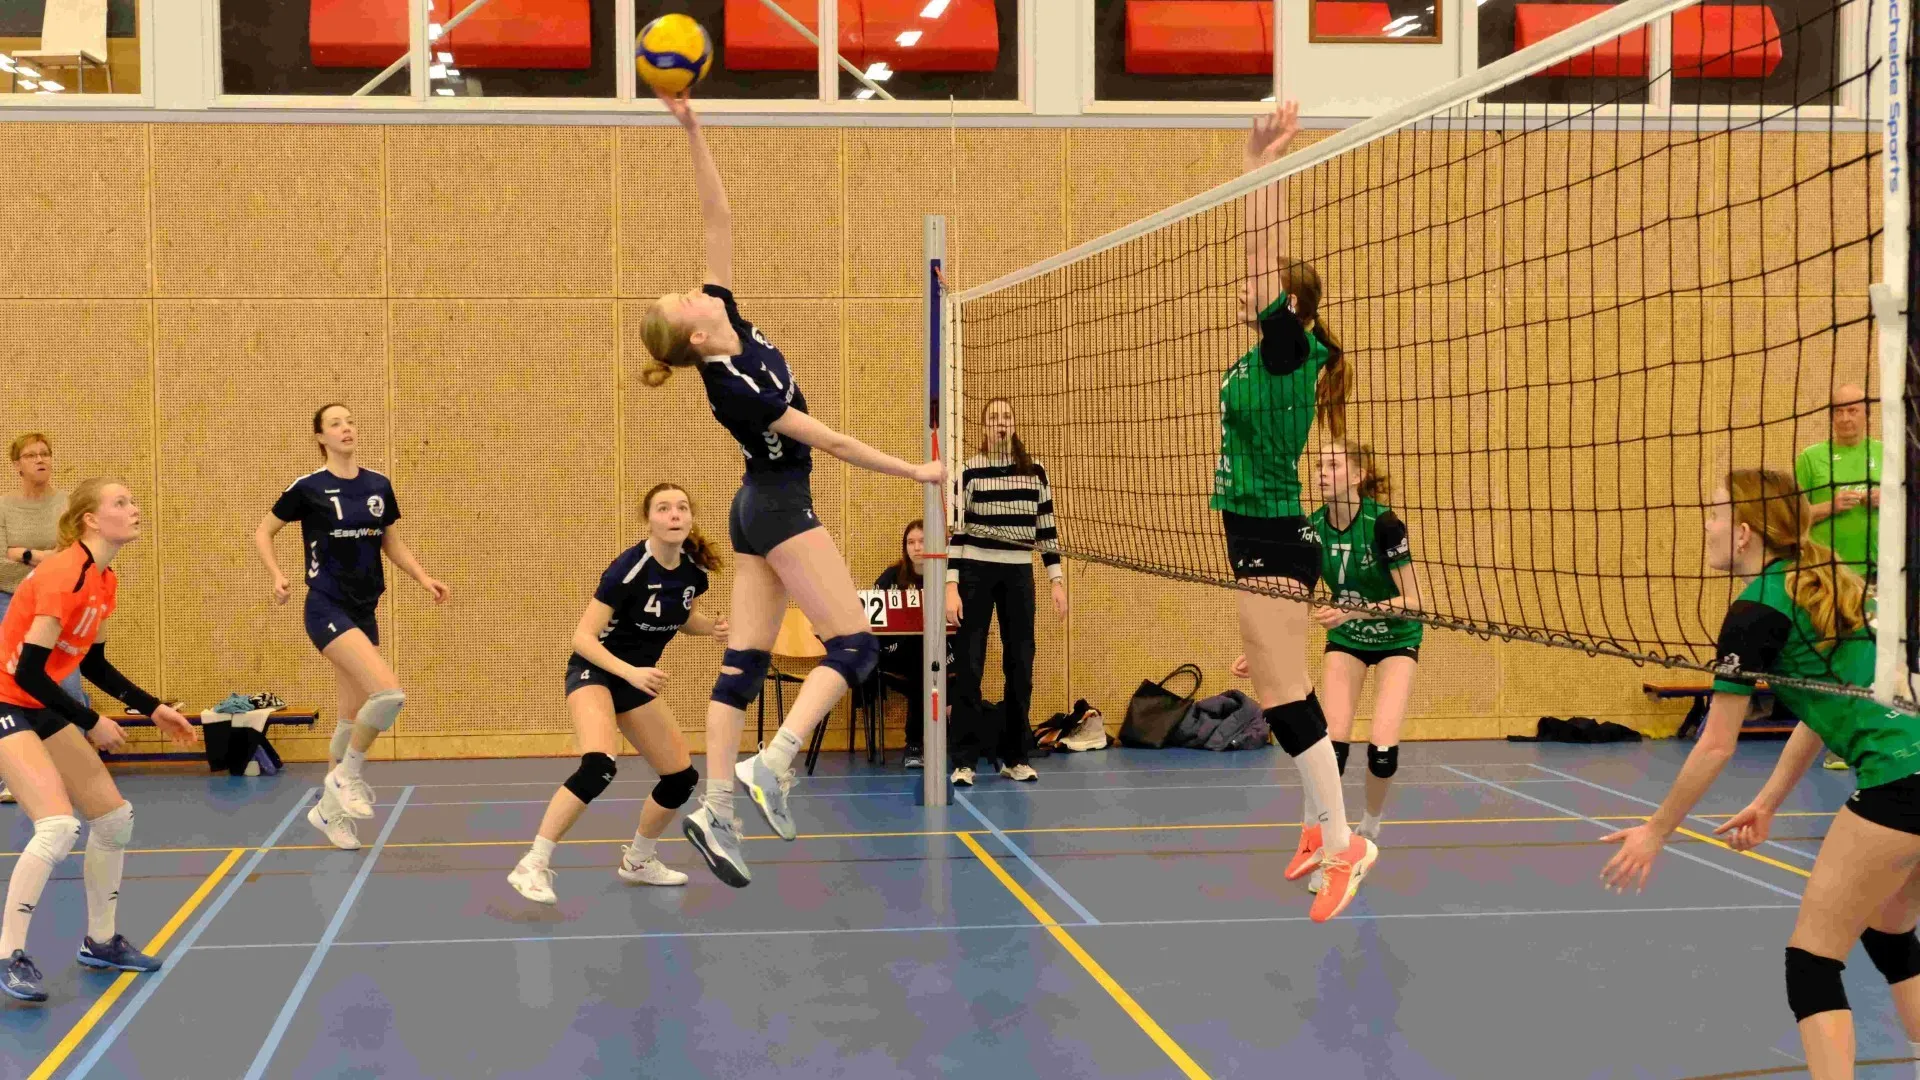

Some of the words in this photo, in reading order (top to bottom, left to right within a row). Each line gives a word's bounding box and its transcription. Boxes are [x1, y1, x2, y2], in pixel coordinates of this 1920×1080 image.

[1888, 0, 1900, 95] chelde
[1887, 101, 1900, 194] Sports
[330, 496, 344, 520] 1
[1331, 543, 1352, 585] 7
[643, 592, 661, 618] 4
[892, 595, 899, 607] 0
[910, 594, 918, 606] 2
[327, 622, 337, 632] 1
[580, 669, 590, 680] 4
